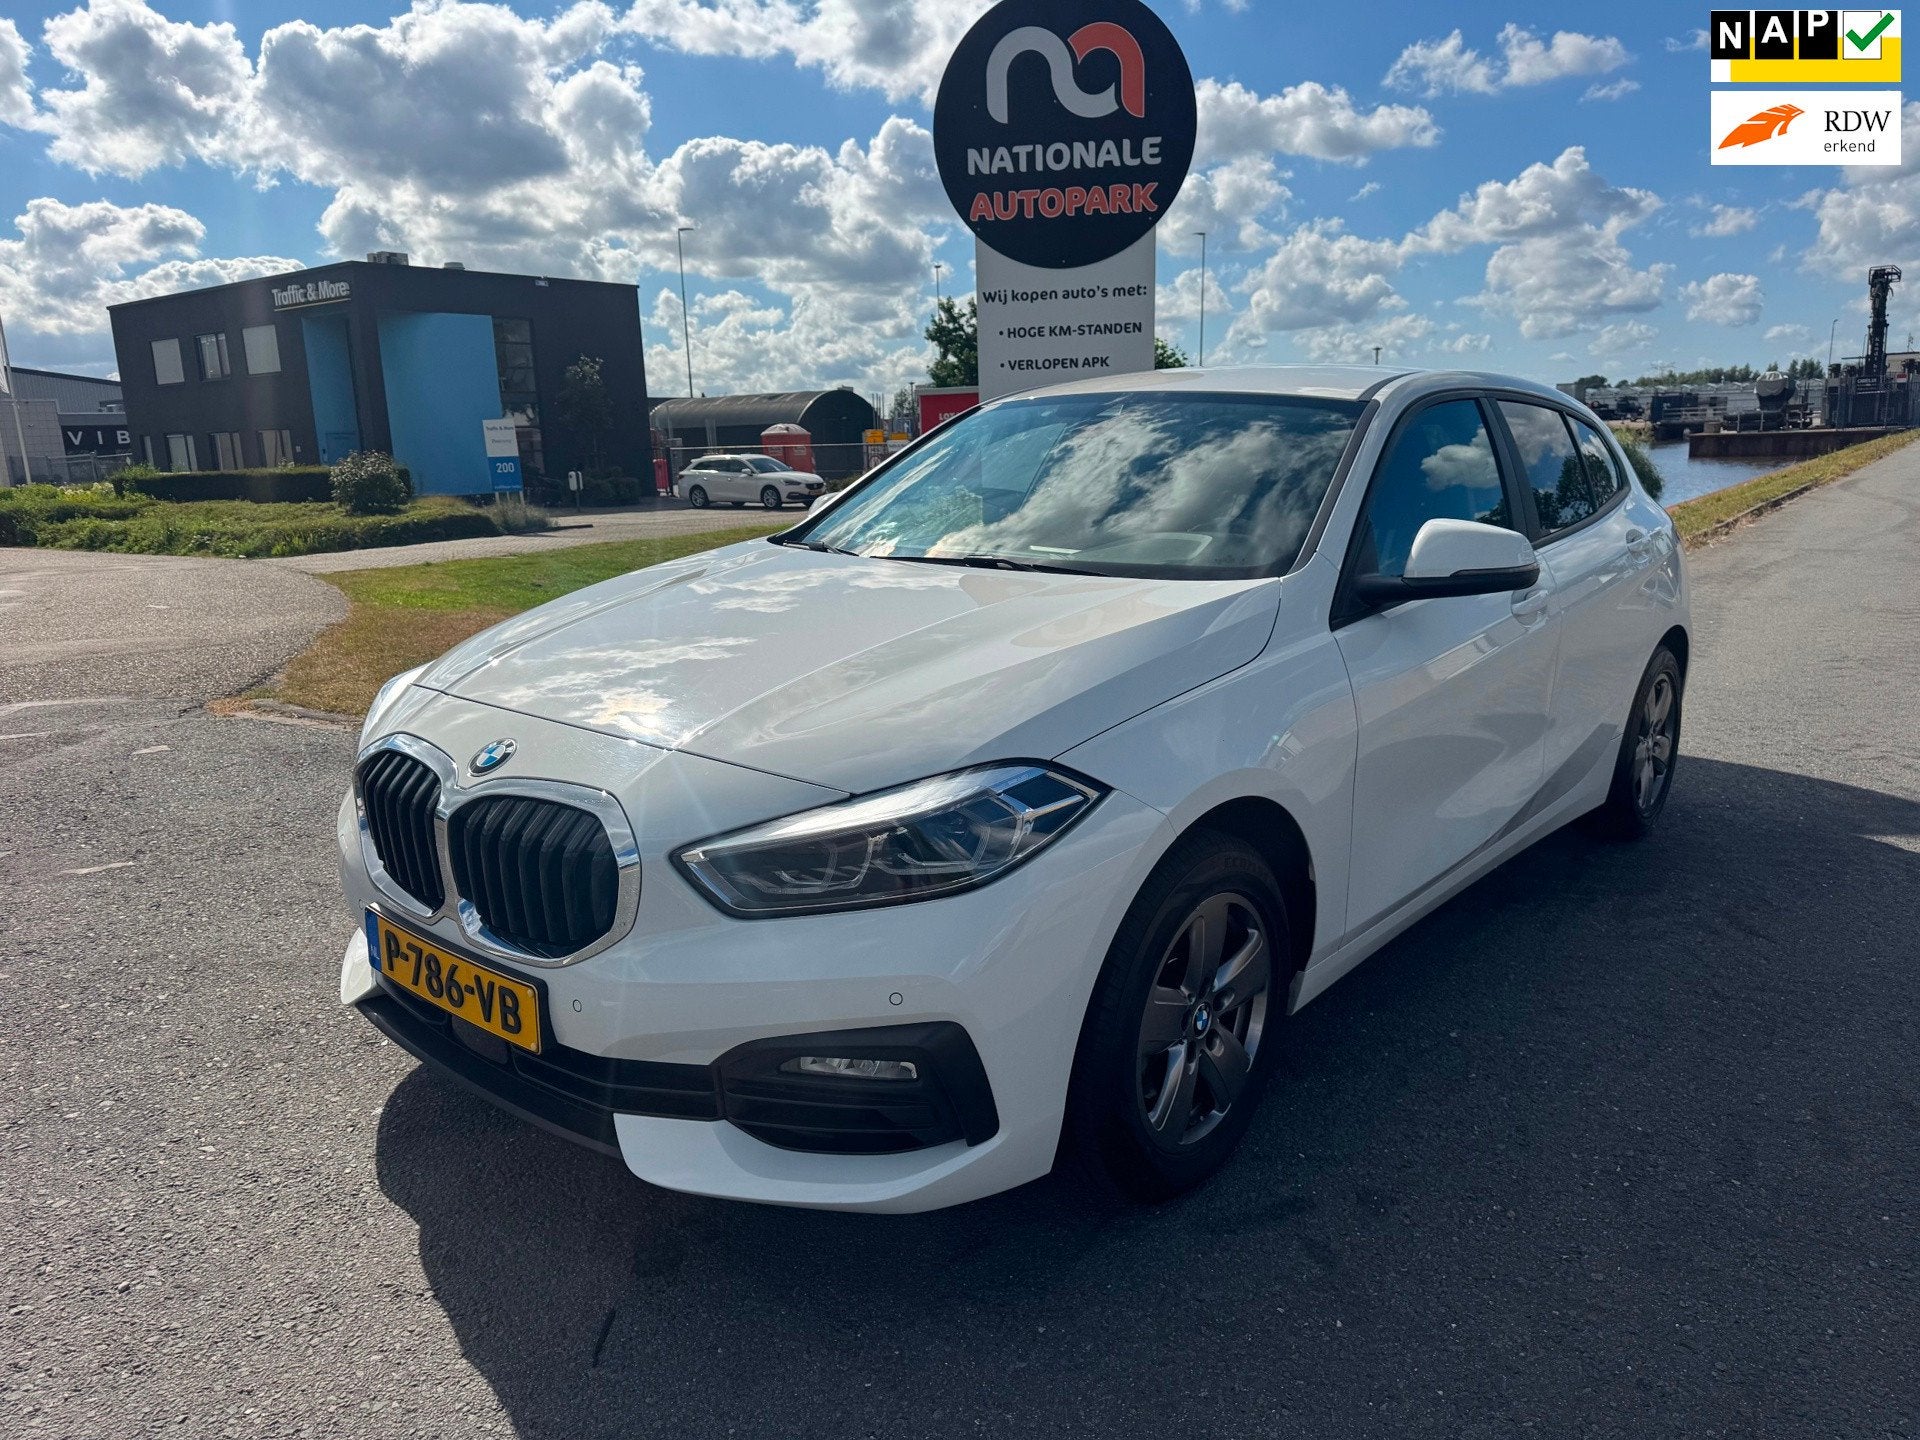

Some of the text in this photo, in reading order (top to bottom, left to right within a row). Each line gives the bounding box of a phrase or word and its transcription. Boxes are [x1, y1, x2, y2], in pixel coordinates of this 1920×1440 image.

[967, 136, 1162, 176] NATIONALE
[969, 182, 1159, 222] AUTOPARK
[272, 284, 306, 306] Traffic
[306, 283, 318, 301] &
[982, 284, 1147, 305] Wij kopen auto's met:
[1007, 321, 1142, 338] HOGE KM-STANDEN
[1008, 356, 1110, 371] VERLOPEN APK
[496, 462, 515, 473] 200
[384, 929, 522, 1035] P-786-VB
